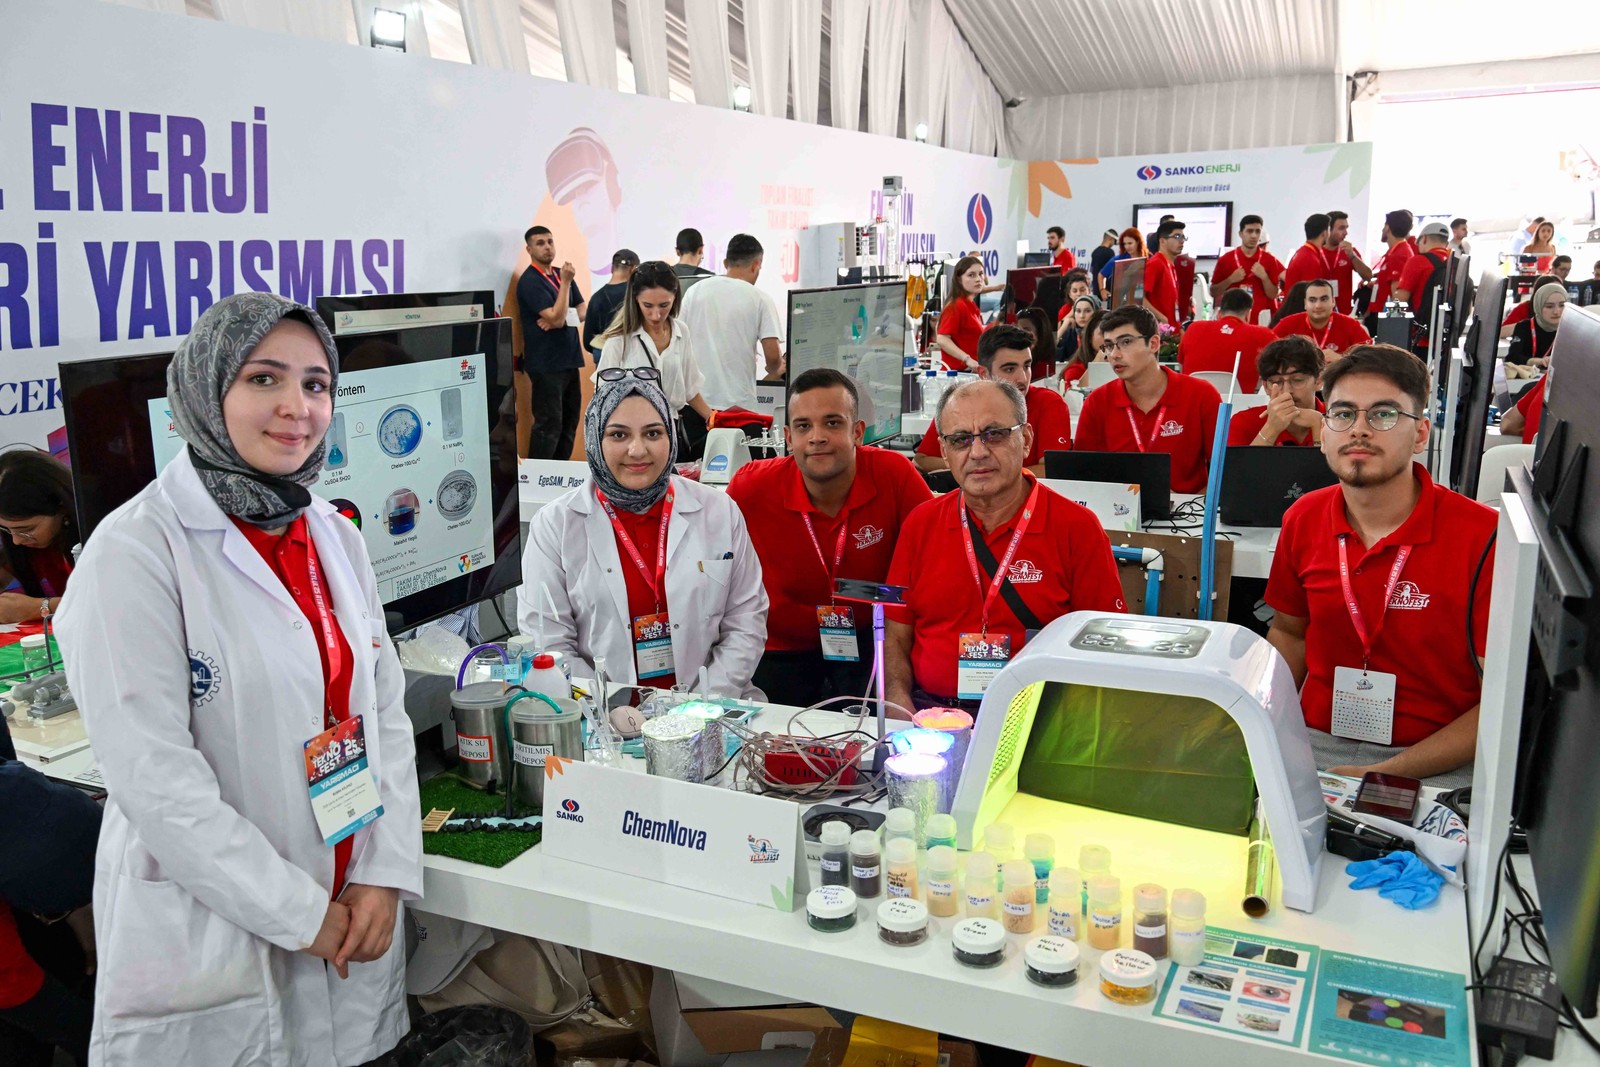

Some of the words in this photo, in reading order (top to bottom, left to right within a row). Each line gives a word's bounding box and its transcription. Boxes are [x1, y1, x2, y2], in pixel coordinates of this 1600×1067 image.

[31, 102, 268, 214] ENERJİ
[337, 383, 366, 398] öntem
[1387, 599, 1430, 608] EKNOFEST
[474, 739, 486, 747] SU
[526, 754, 546, 765] DEPOS
[556, 810, 584, 823] SANKO
[622, 810, 707, 851] ChemNova
